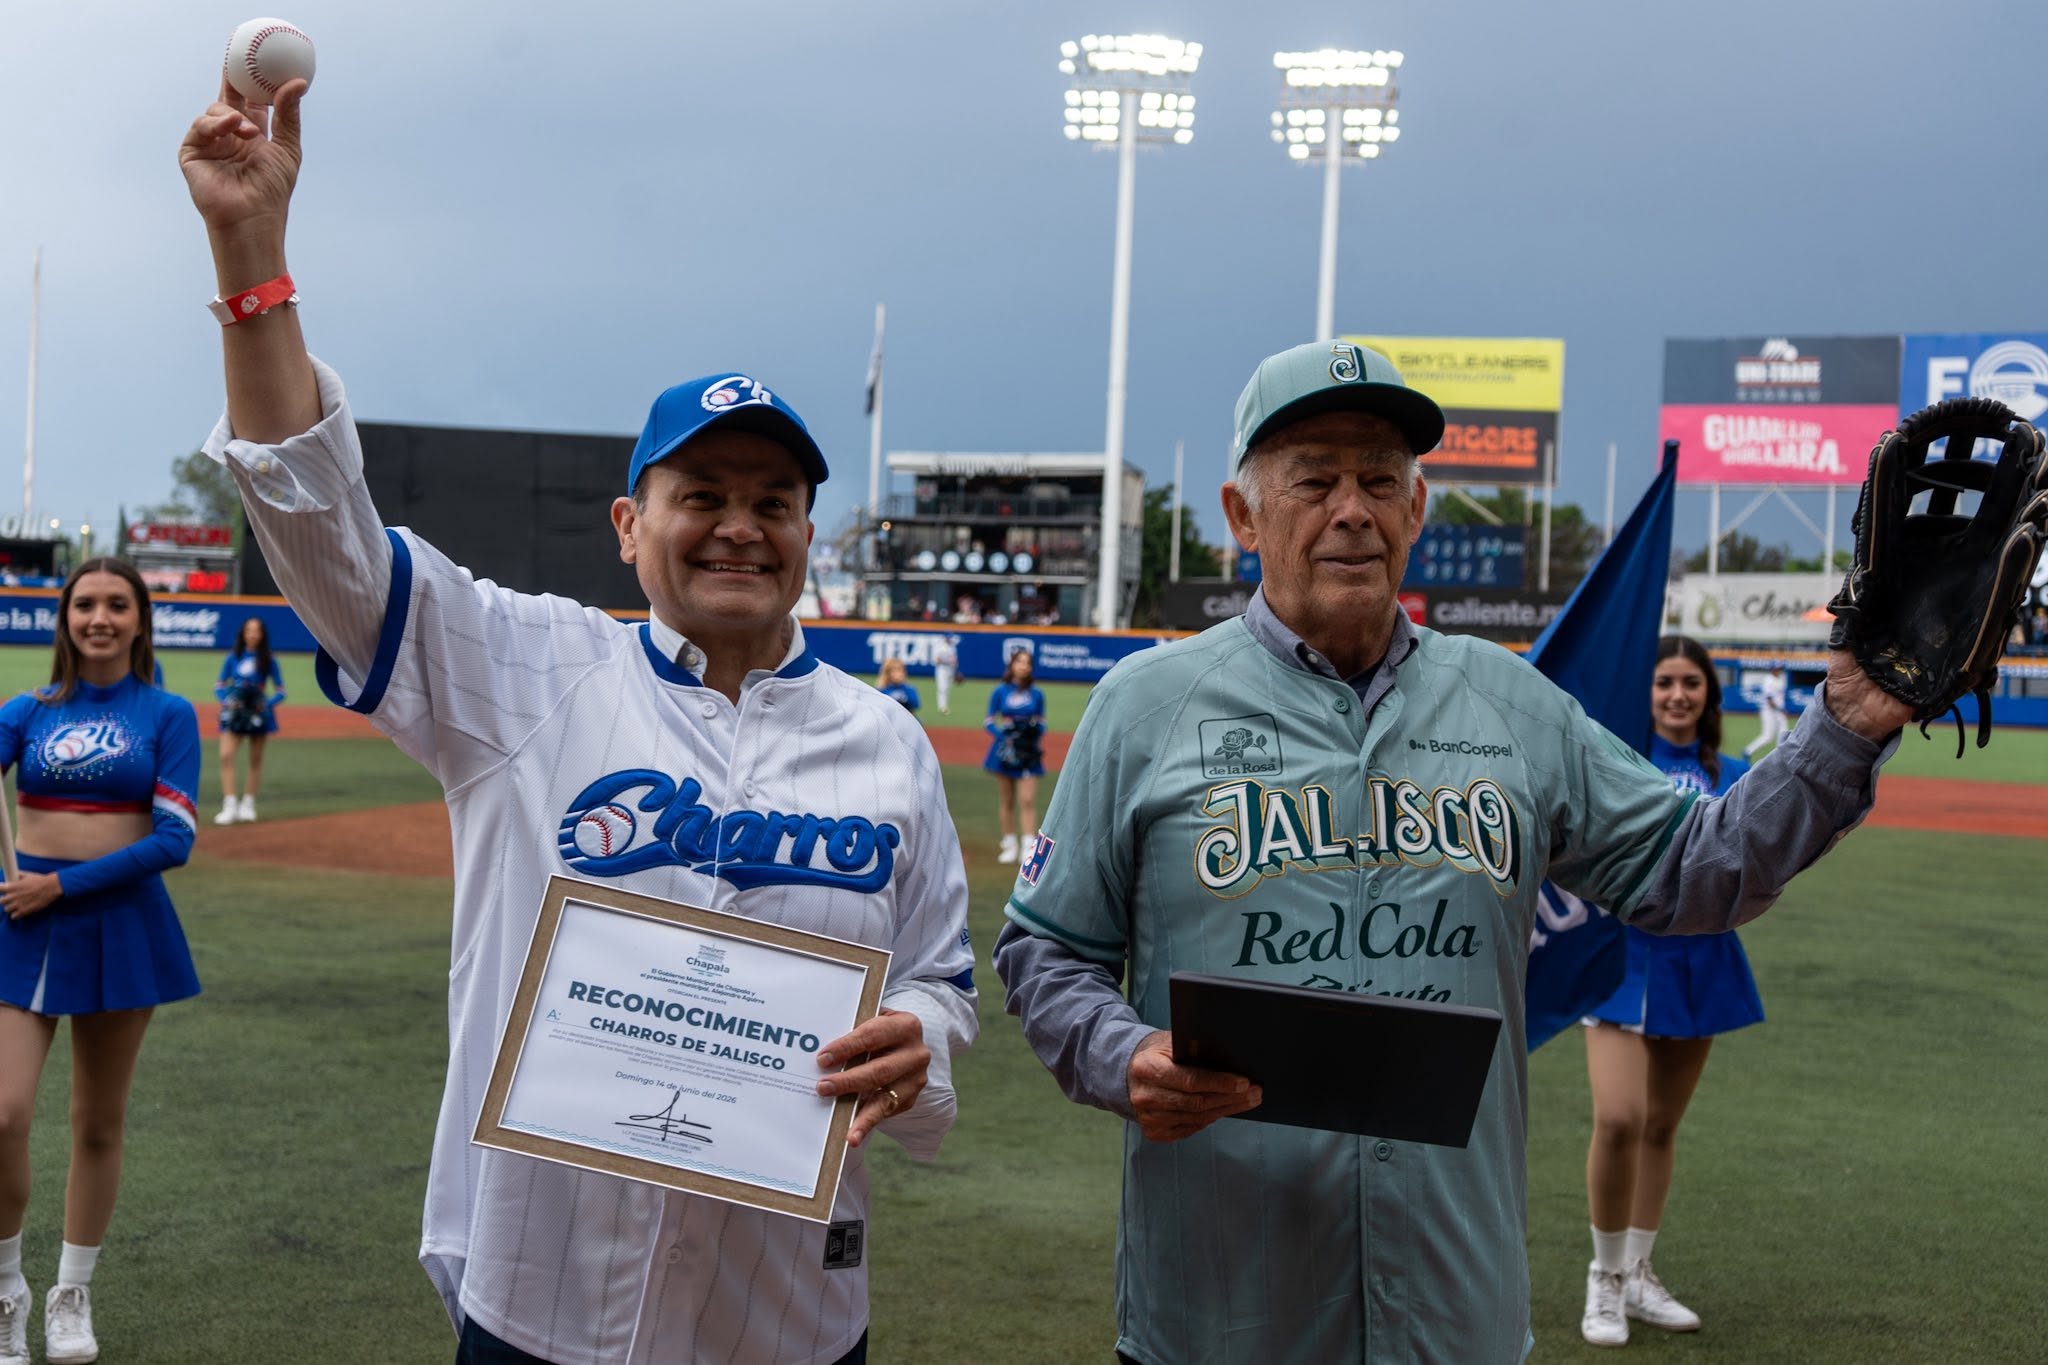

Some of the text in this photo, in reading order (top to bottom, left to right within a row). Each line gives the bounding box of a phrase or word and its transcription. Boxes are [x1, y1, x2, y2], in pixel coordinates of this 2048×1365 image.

[1430, 739, 1513, 758] BanCoppel
[1209, 760, 1277, 776] de la Rosa
[558, 768, 900, 894] Charros
[1194, 778, 1521, 900] JALISCO
[1232, 902, 1354, 967] Red
[1359, 899, 1479, 961] Cola
[686, 956, 731, 974] Chapala
[646, 974, 678, 984] presidente
[711, 988, 740, 997] Alejandro
[741, 995, 765, 1003] Aguirre
[657, 970, 685, 978] Gobierno
[686, 976, 715, 985] Municipal
[724, 985, 750, 994] Chapala
[567, 980, 820, 1053] RECONOCIMIENTO
[590, 1016, 677, 1046] CHARROS
[681, 1037, 707, 1053] DE
[710, 1043, 785, 1070] JALISCO
[614, 1071, 737, 1104] Domingo 14 de junio del 2026
